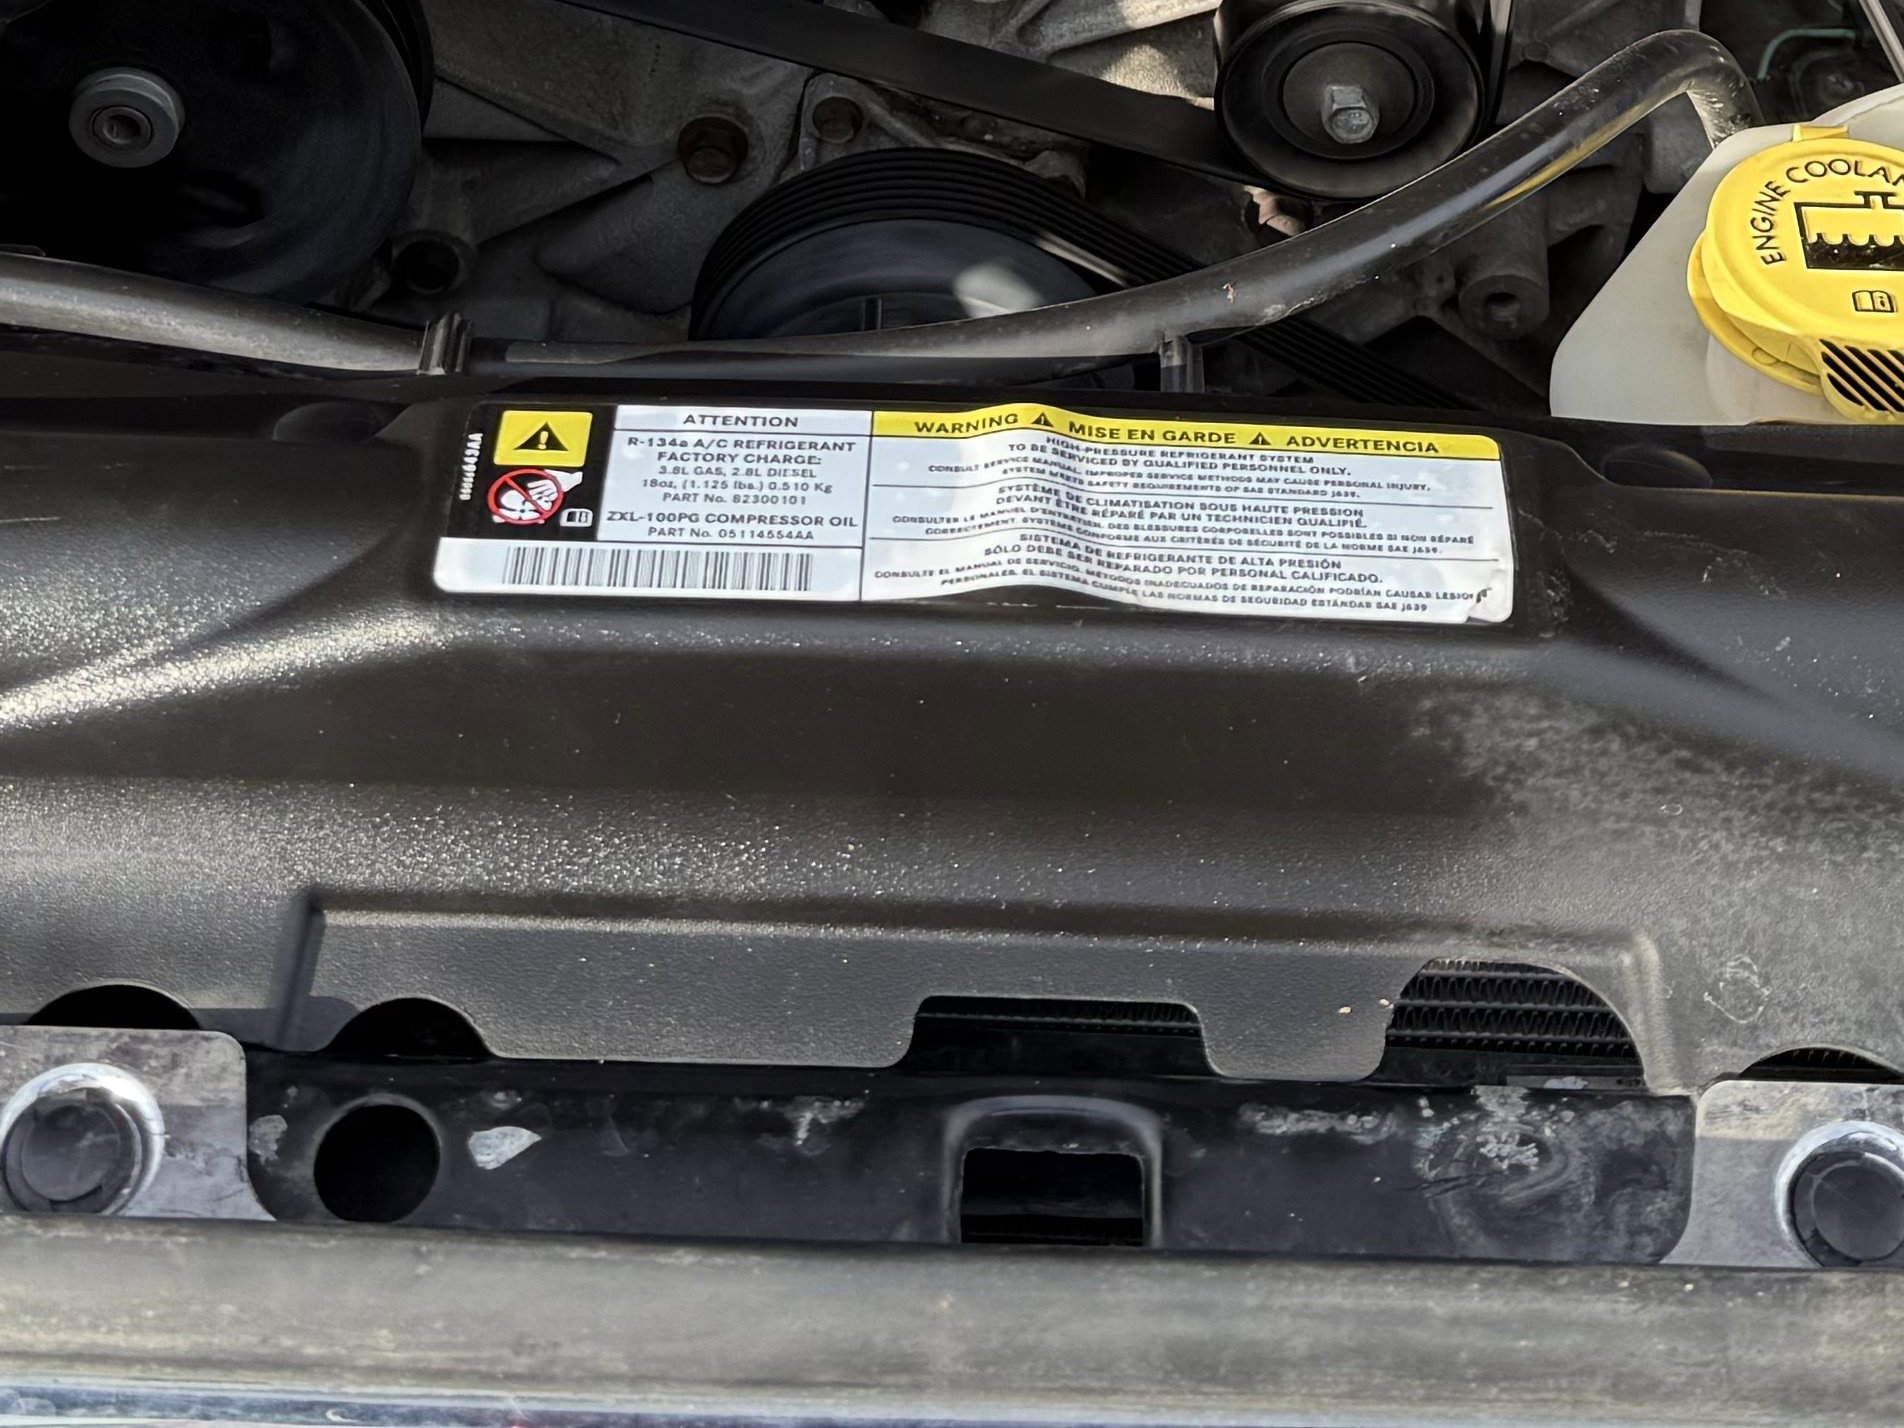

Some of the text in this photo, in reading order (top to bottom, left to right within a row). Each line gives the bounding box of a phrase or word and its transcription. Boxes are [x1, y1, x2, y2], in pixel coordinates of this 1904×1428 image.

[1750, 180, 1791, 266] ENGINE
[684, 415, 798, 427] ATTENTION
[914, 413, 1440, 454] WARNING MISE EN GARDE ADVERTENCIA
[628, 437, 856, 451] R-134a A/C REFRIGERANT
[657, 452, 821, 465] FACTORY CHARGE:
[1008, 443, 1352, 476] TO BE SERVICED BY QUALIFIED PERSONNEL ONLY.
[1160, 450, 1255, 461] REFRIGERANT
[1259, 454, 1314, 463] SYSTEM
[658, 466, 689, 475] 3.8L
[732, 467, 761, 477] 2.8L
[767, 468, 817, 478] DIESEL
[815, 483, 832, 494] Kg
[1256, 476, 1281, 485] MAY
[1284, 478, 1320, 487] CAUSE
[1324, 480, 1384, 489] PERSONAL
[663, 493, 699, 502] PART
[704, 494, 727, 503] No.
[1267, 487, 1328, 497] STANDARD
[996, 493, 1051, 507] DEVANT
[1149, 511, 1177, 521] PAR
[1181, 513, 1202, 522] UN
[1206, 514, 1293, 526] TECHNICIEN
[1065, 490, 1082, 500] DE
[1086, 497, 1195, 511] CLIMATISATION
[1200, 502, 1238, 512] SOUS
[1242, 504, 1289, 515] HAUTE
[1293, 506, 1364, 518] PRESSION
[607, 511, 858, 527] ZXL-100PG COMPRESSOR OIL
[648, 527, 712, 538] PART No.
[1019, 533, 1342, 570] SISTEMA DE REFRIGERANTE DE ALTA PRESIÓN
[1026, 544, 1063, 556] DEBE
[1067, 550, 1093, 565] SER
[1096, 560, 1172, 575] REPARADO
[1177, 565, 1207, 576] POR
[1211, 567, 1287, 580] PERSONAL
[1291, 570, 1383, 584] CALIFICADO.
